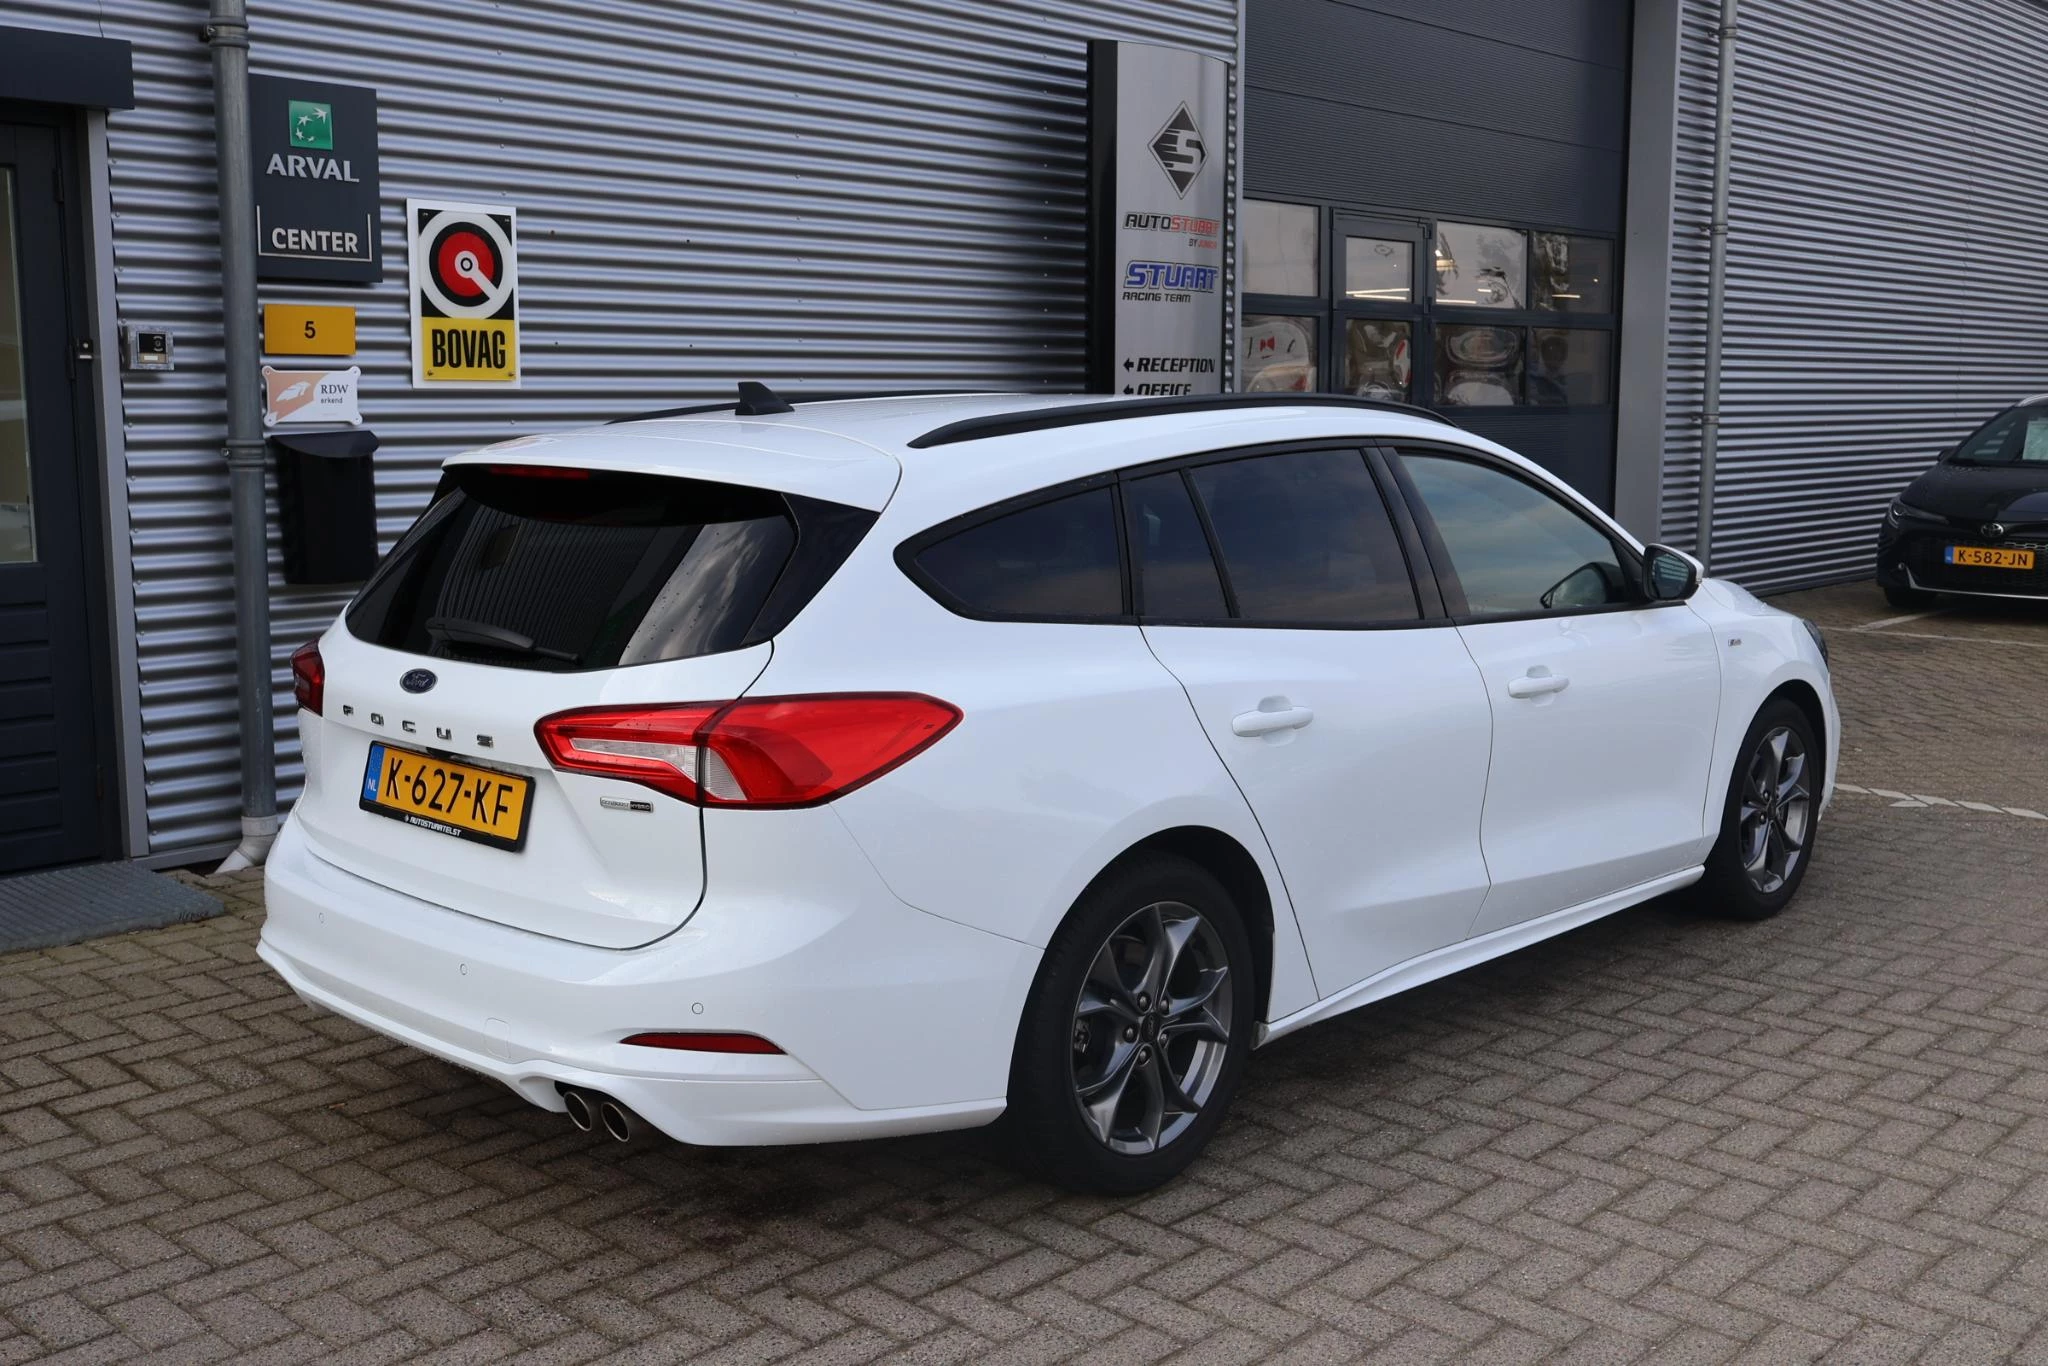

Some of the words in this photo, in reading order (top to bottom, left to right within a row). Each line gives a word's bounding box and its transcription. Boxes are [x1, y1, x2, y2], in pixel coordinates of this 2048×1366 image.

[266, 153, 360, 183] ARVAL
[271, 227, 358, 253] CENTER
[1125, 261, 1218, 291] STUART
[1122, 291, 1161, 301] RACING
[1165, 293, 1191, 302] TEAM
[304, 320, 316, 339] 5
[432, 328, 506, 369] BOVAG
[1136, 357, 1216, 373] RECEPTION
[321, 384, 349, 395] RDW
[1137, 383, 1192, 396] OFFICE
[1958, 549, 2028, 566] K-582-JN
[343, 704, 493, 748] FOCUS
[367, 778, 377, 791] NL
[386, 757, 513, 826] K-627-KF
